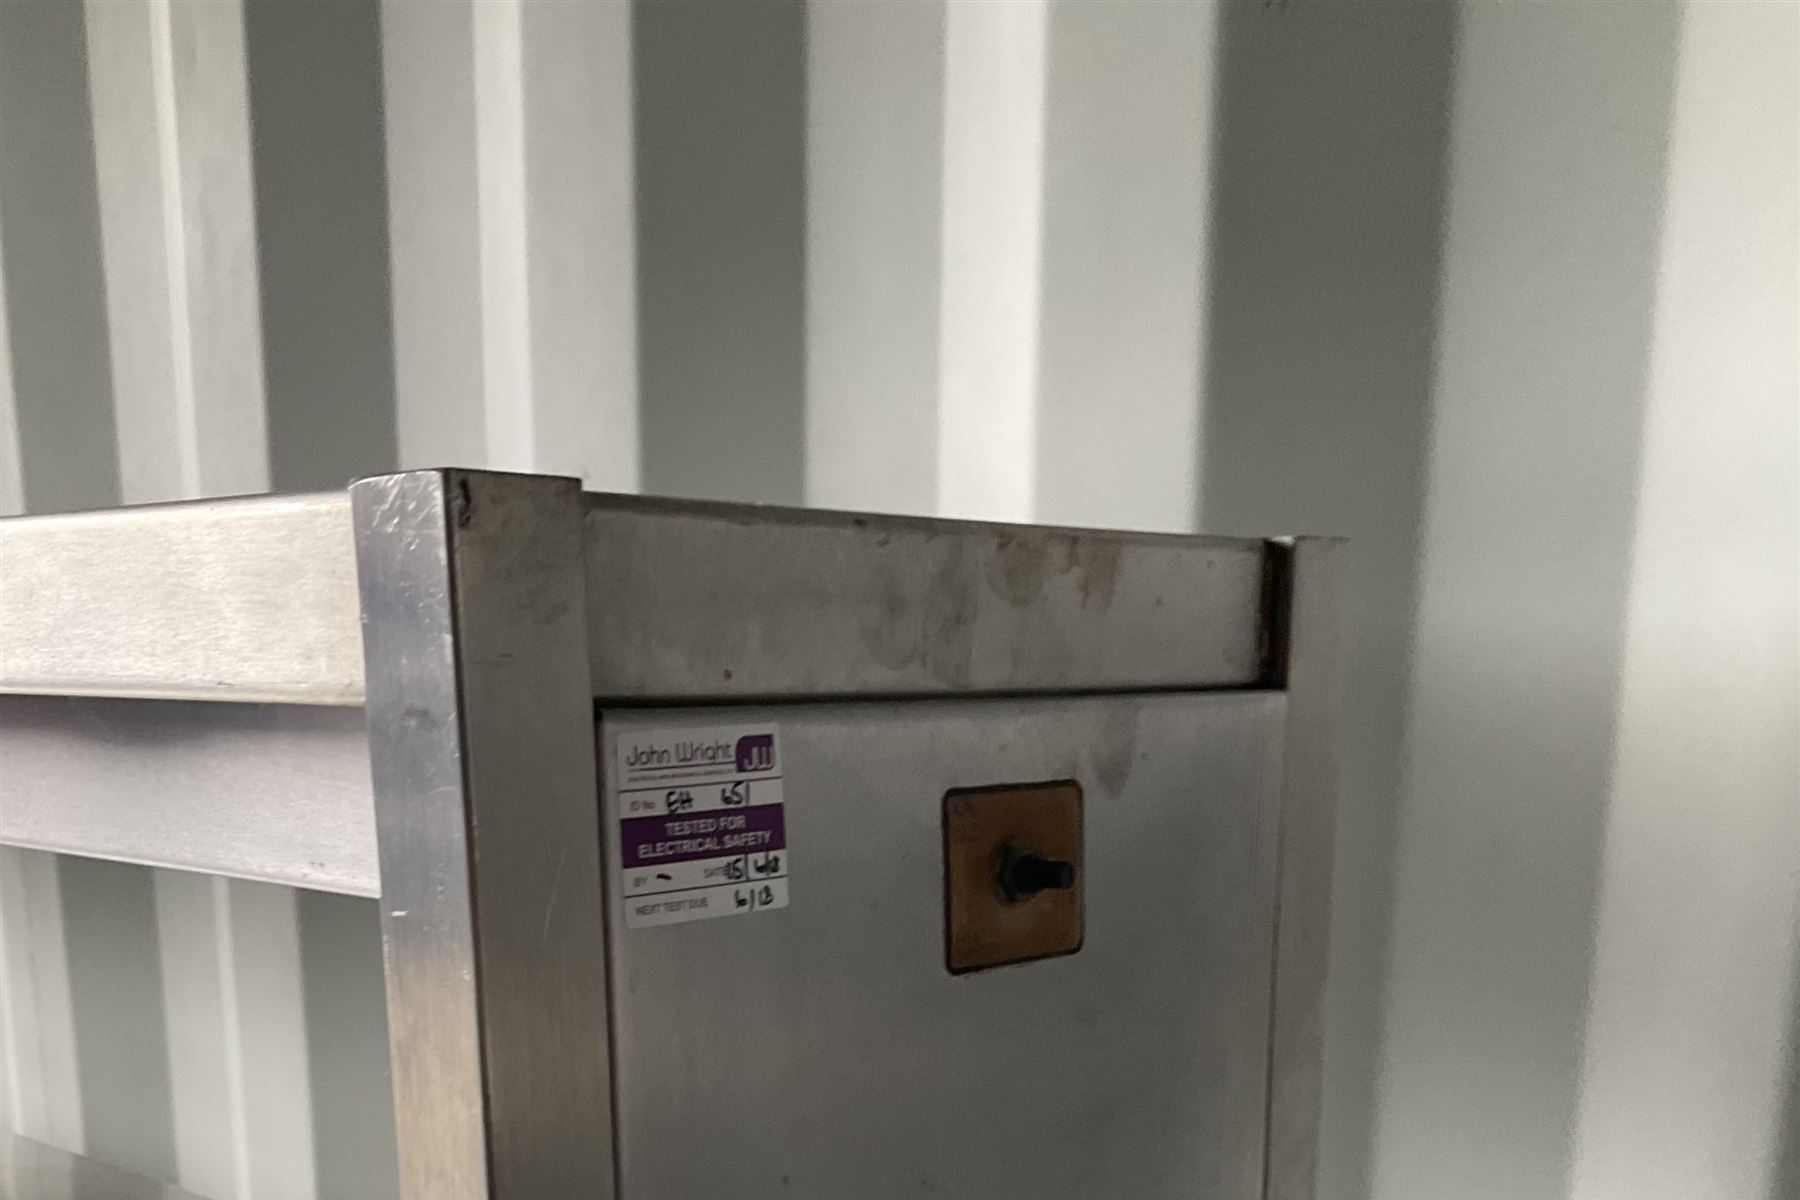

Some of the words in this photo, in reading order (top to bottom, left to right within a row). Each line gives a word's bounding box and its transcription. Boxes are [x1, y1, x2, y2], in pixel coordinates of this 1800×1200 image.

[626, 744, 671, 767] John
[675, 740, 734, 766] Wright
[664, 818, 717, 837] TESTED
[719, 814, 746, 832] FOR
[637, 836, 720, 860] ELECTRICAL
[722, 830, 772, 850] SAFETY
[635, 902, 662, 917] NEXT
[662, 899, 687, 914] TEST
[688, 896, 709, 911] DUE
